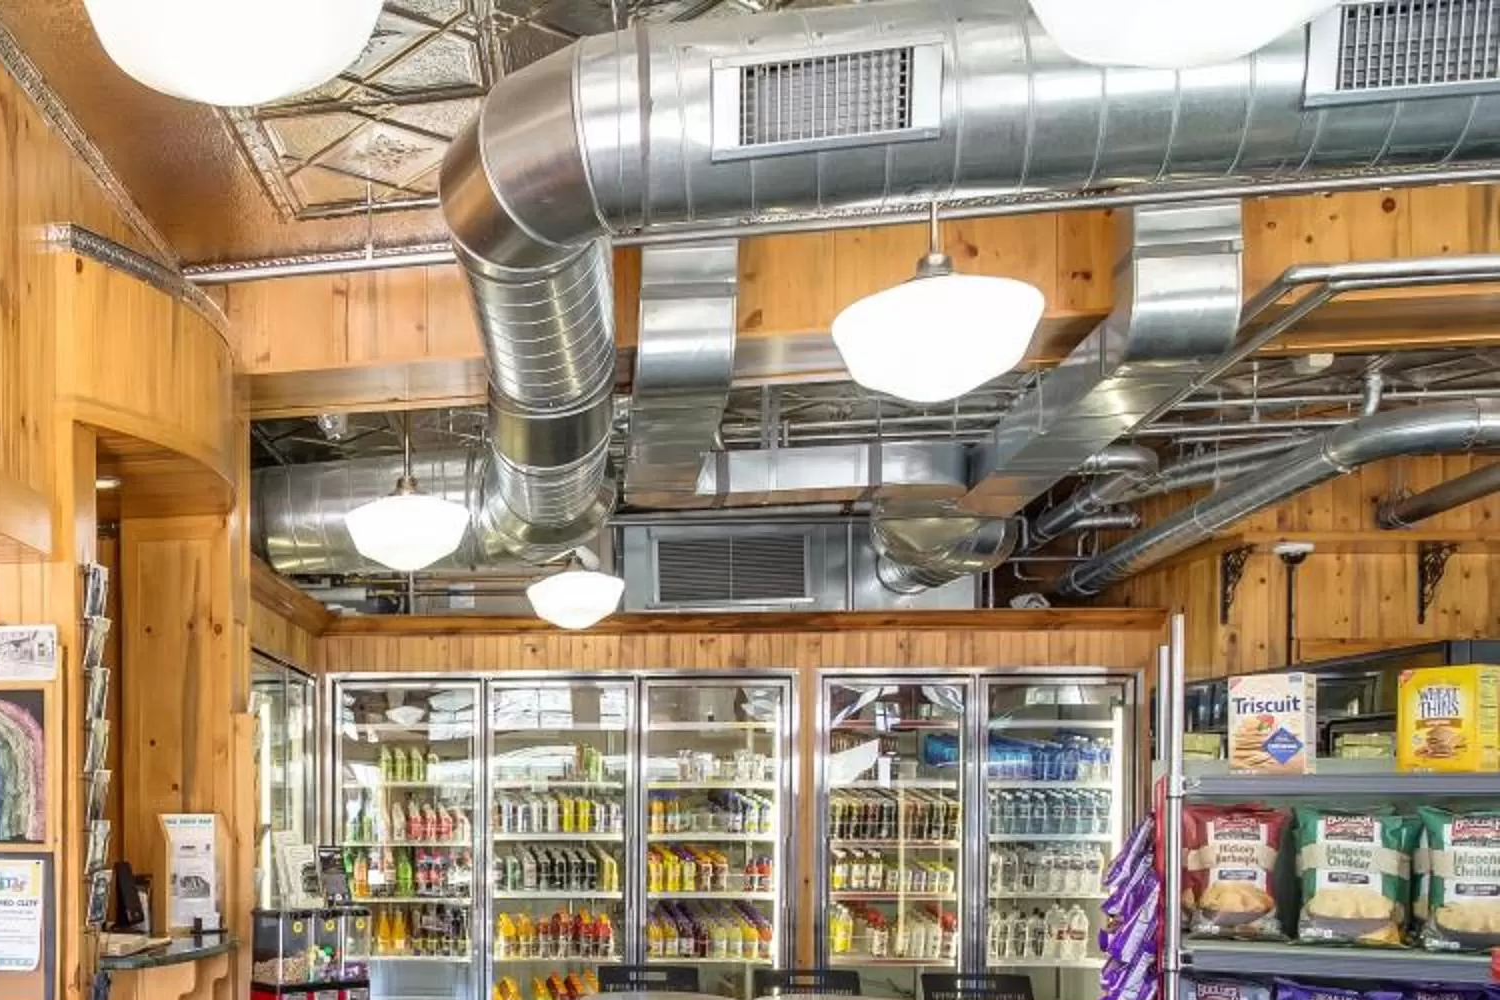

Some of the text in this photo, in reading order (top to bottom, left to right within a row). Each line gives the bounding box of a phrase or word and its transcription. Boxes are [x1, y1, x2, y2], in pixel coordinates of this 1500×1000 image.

[1417, 687, 1460, 700] WHEAT
[1232, 695, 1301, 714] Triscuit
[1419, 700, 1459, 718] THINS
[1327, 856, 1371, 869] Cheddar
[1453, 850, 1500, 865] Jalapeñ
[1454, 864, 1500, 877] Chedda
